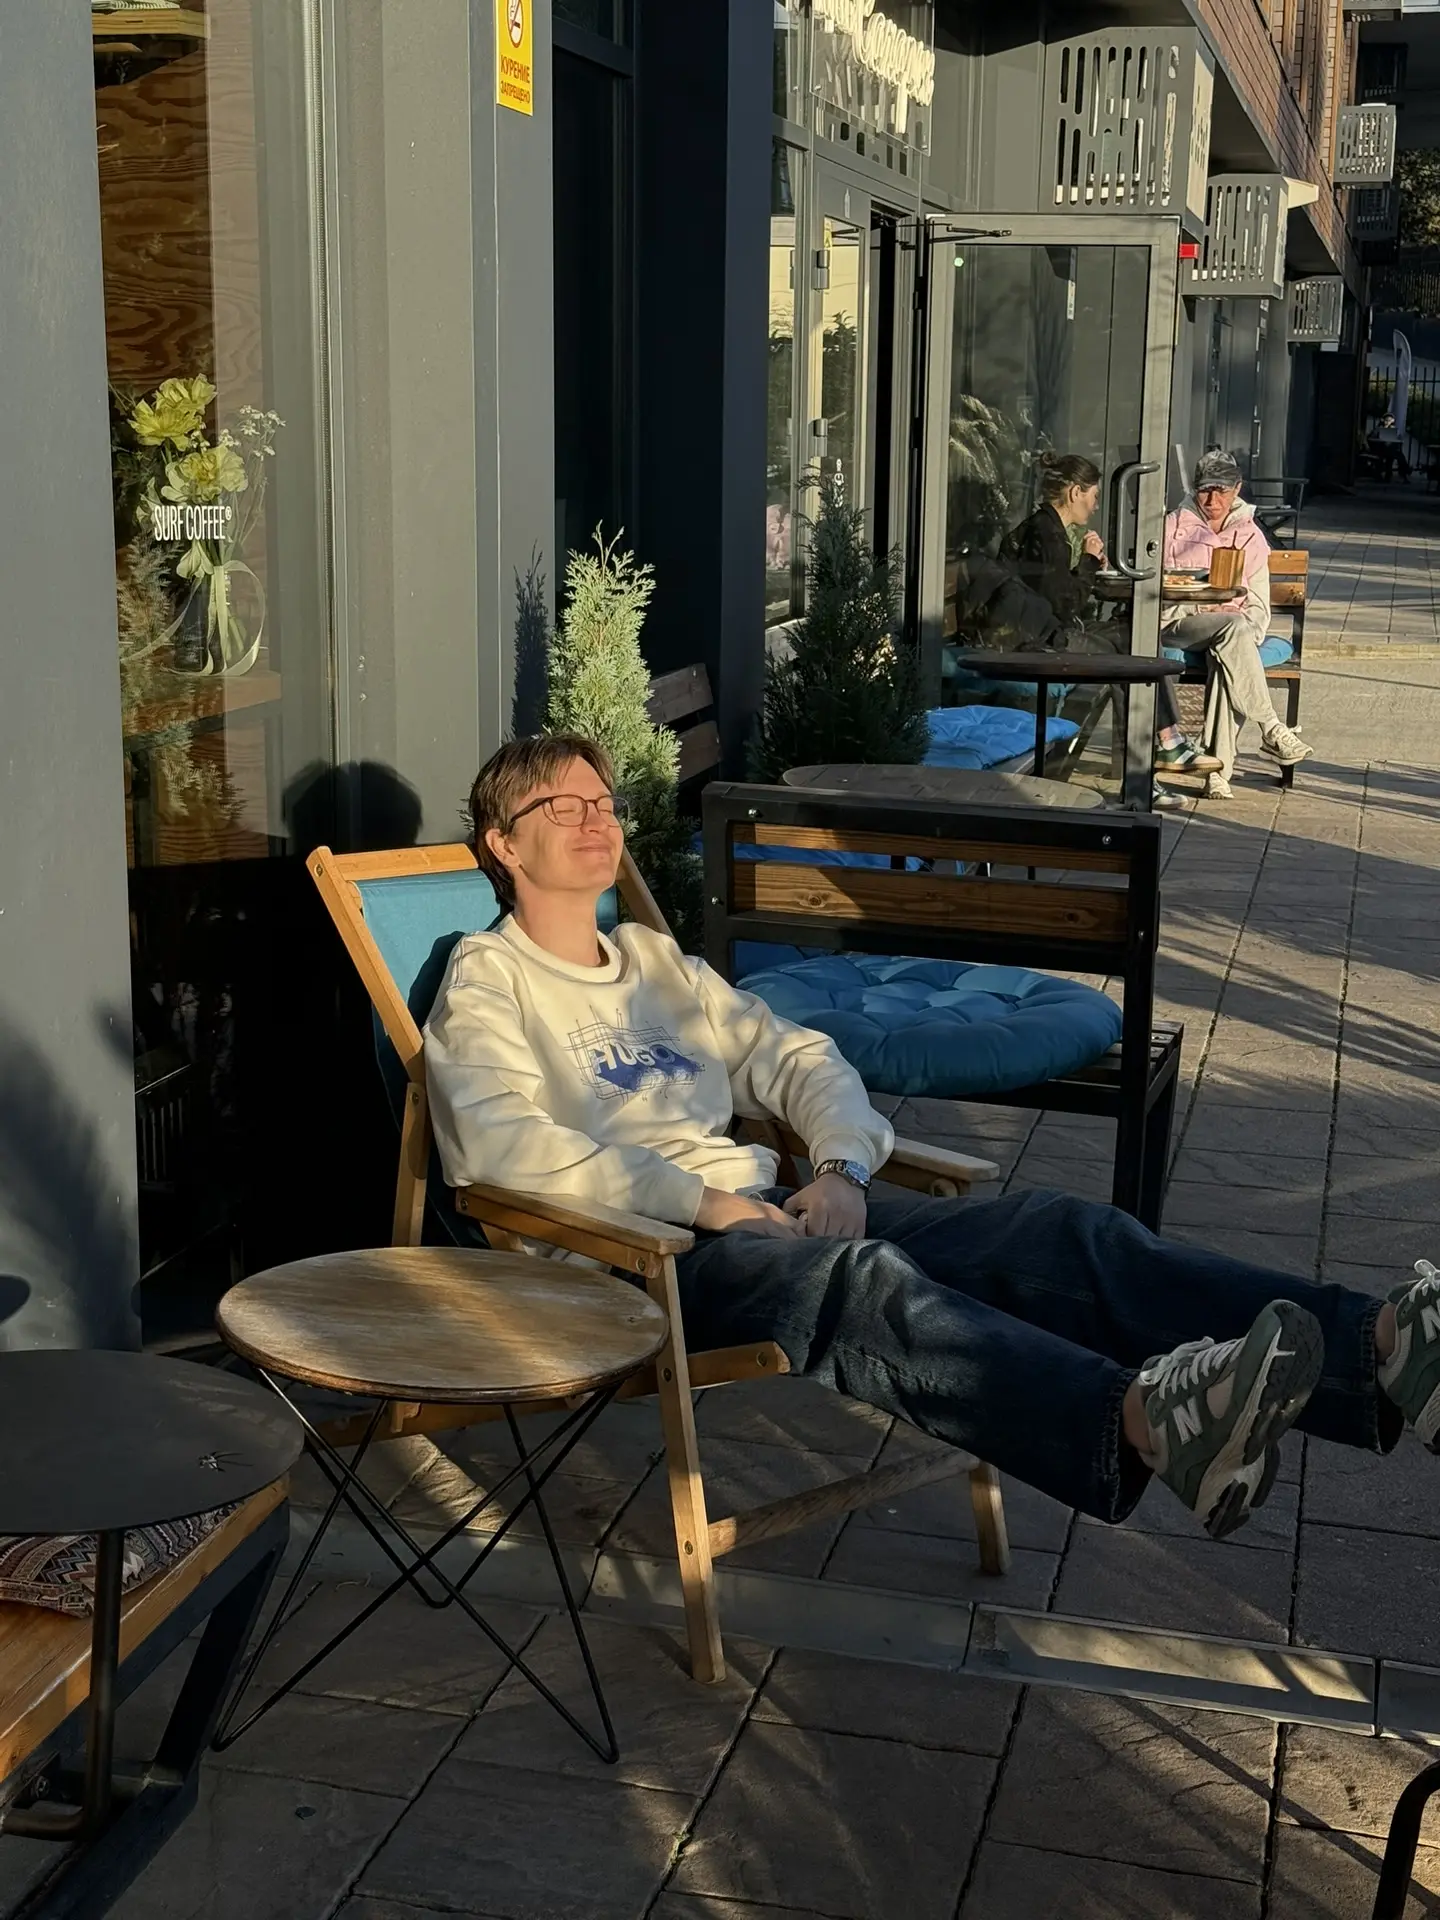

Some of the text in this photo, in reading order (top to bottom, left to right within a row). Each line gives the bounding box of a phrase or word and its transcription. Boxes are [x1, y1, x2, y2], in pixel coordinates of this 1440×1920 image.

[500, 54, 530, 84] КУРЕНИЕ
[500, 80, 531, 104] ЗАПРЕЩЕНО
[154, 505, 184, 541] SURF
[589, 1039, 676, 1075] HUGO
[1172, 1395, 1203, 1445] N
